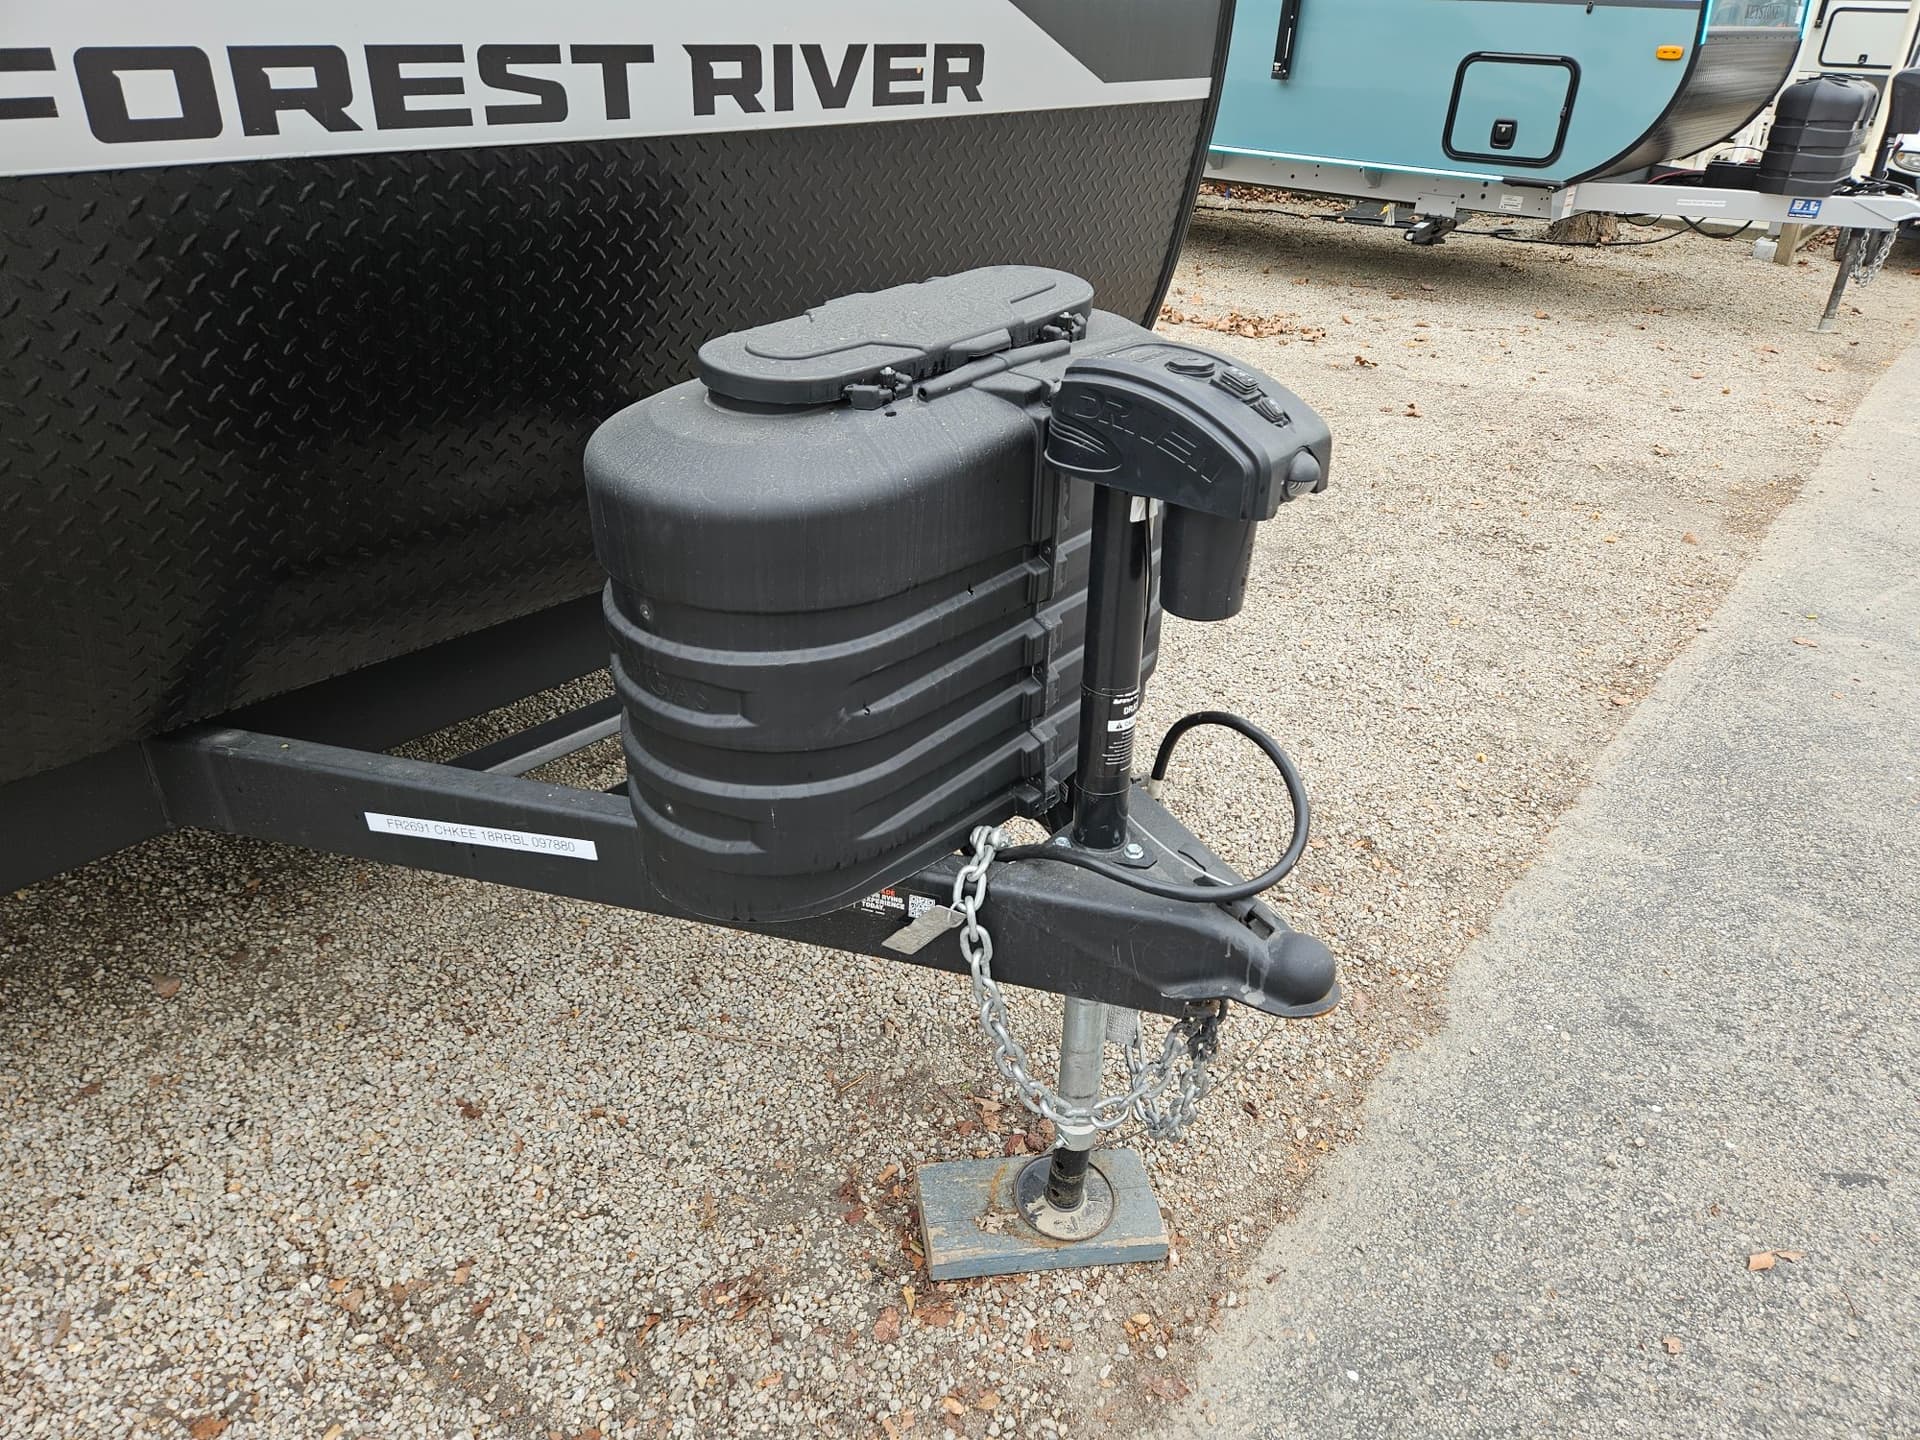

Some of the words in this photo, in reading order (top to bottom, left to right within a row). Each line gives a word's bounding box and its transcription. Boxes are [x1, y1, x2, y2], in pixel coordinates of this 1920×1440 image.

[682, 43, 985, 117] RIVER
[386, 818, 430, 834] FR2691
[434, 825, 480, 840] CHKEE
[481, 831, 529, 847] 18RRBL
[532, 837, 576, 853] 097880
